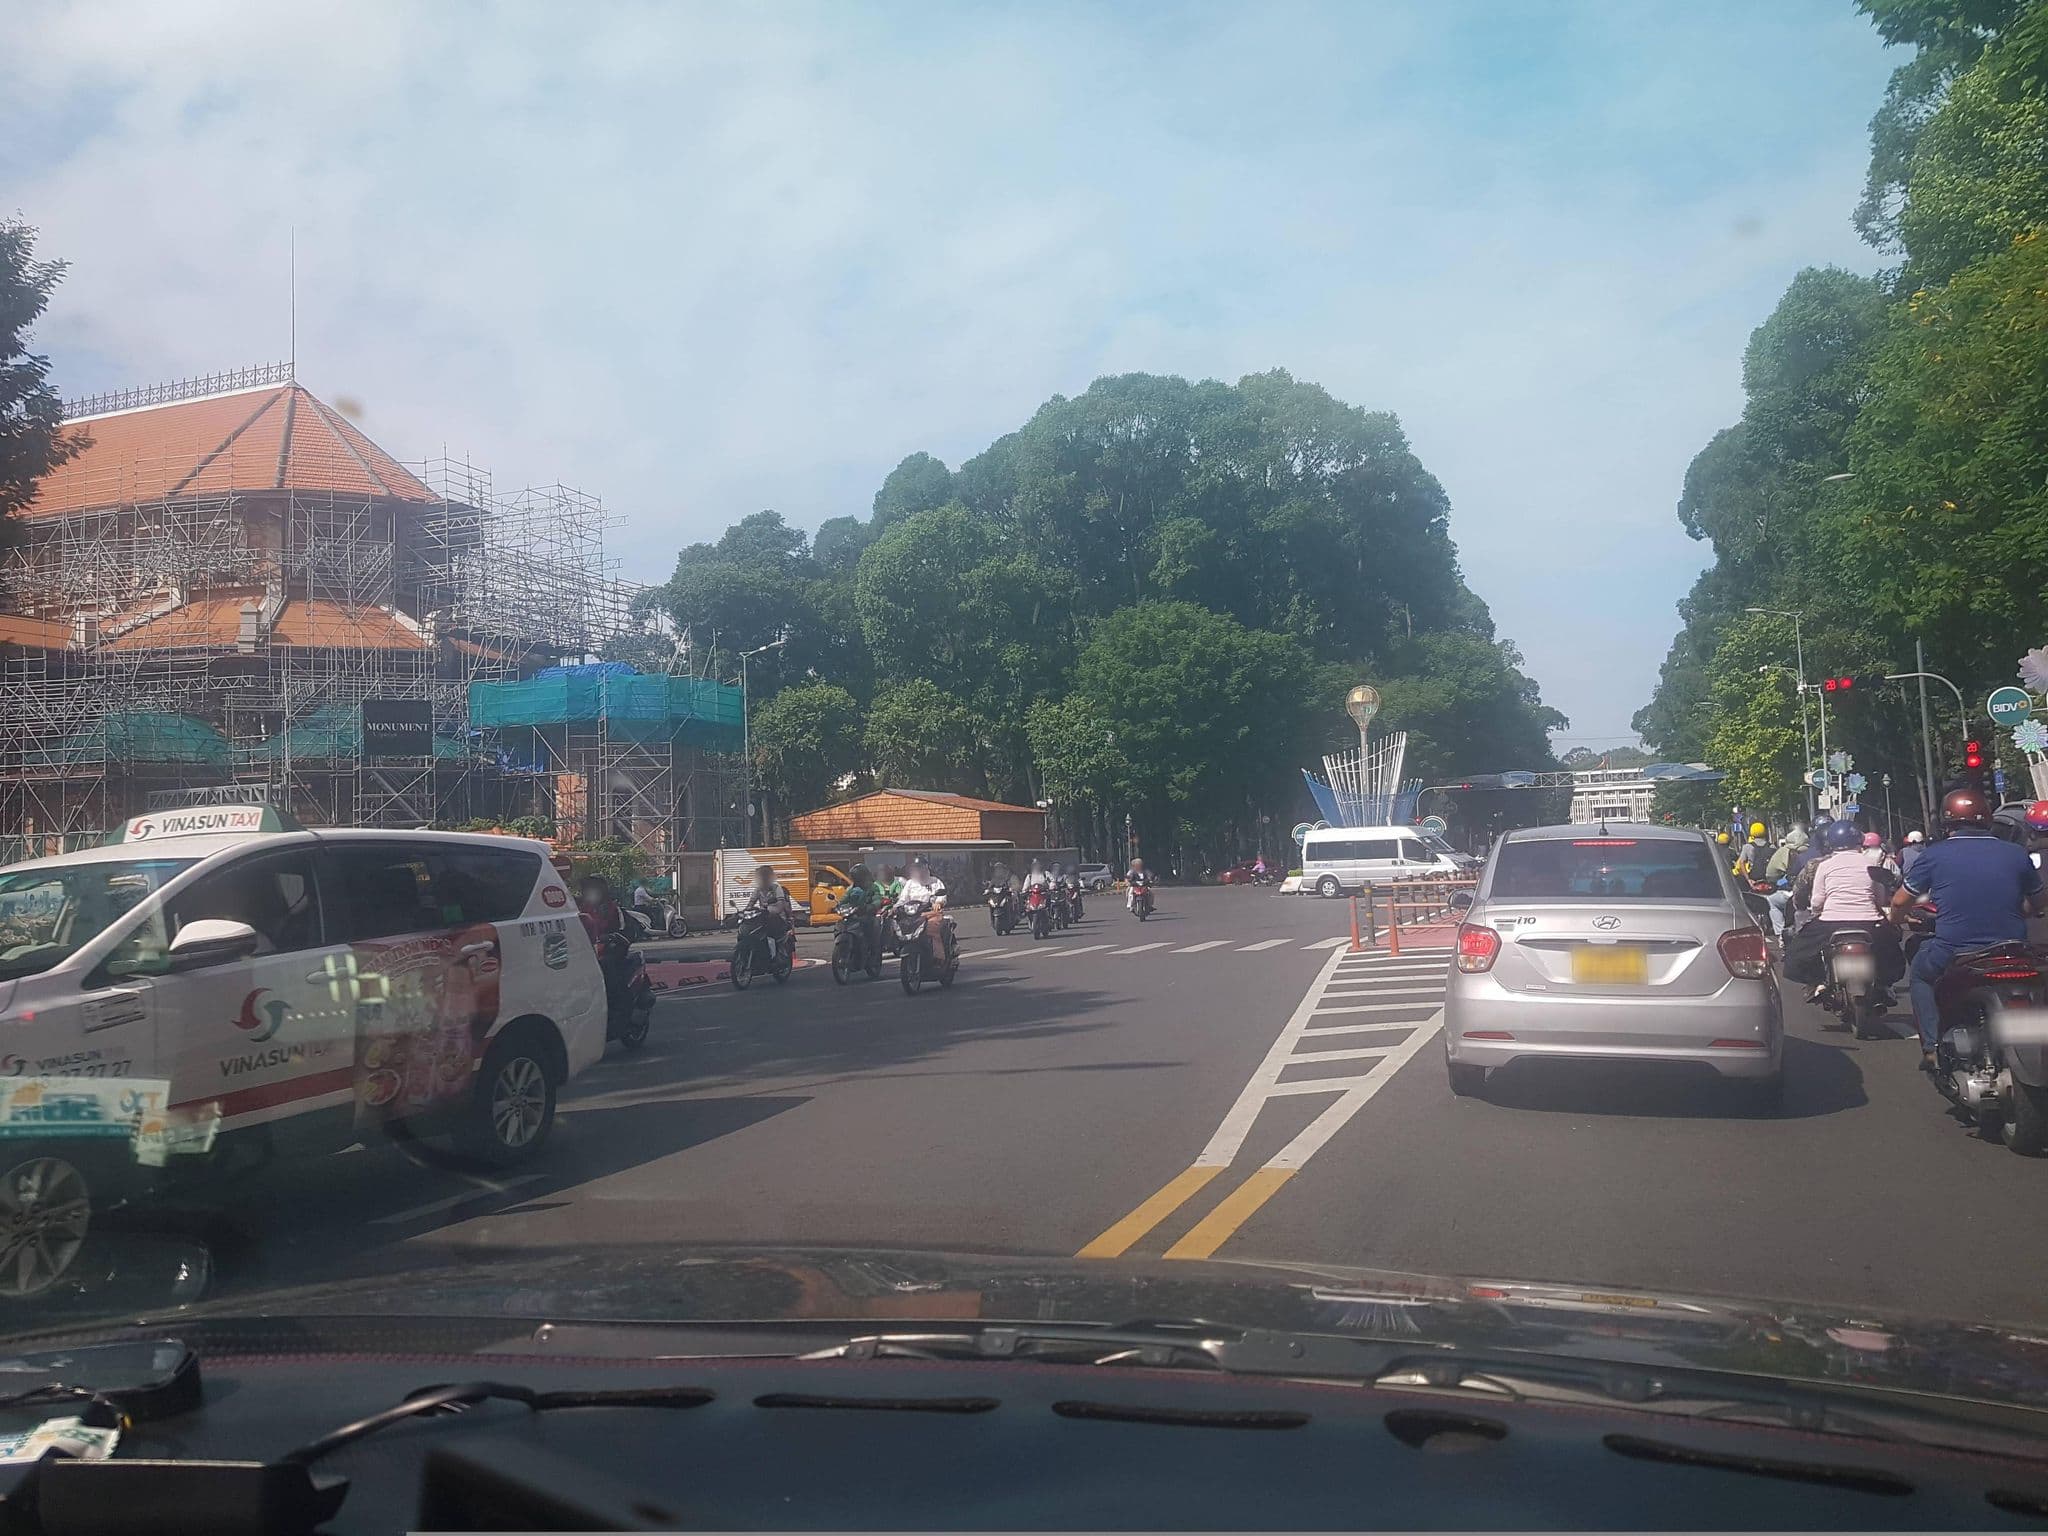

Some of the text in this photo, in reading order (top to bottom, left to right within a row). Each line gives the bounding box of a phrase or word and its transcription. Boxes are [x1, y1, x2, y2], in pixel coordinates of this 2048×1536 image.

[1992, 702, 2019, 713] BIDV
[366, 722, 430, 732] MONUMENT
[1517, 916, 1536, 925] i10
[219, 1043, 305, 1077] VINASUN
